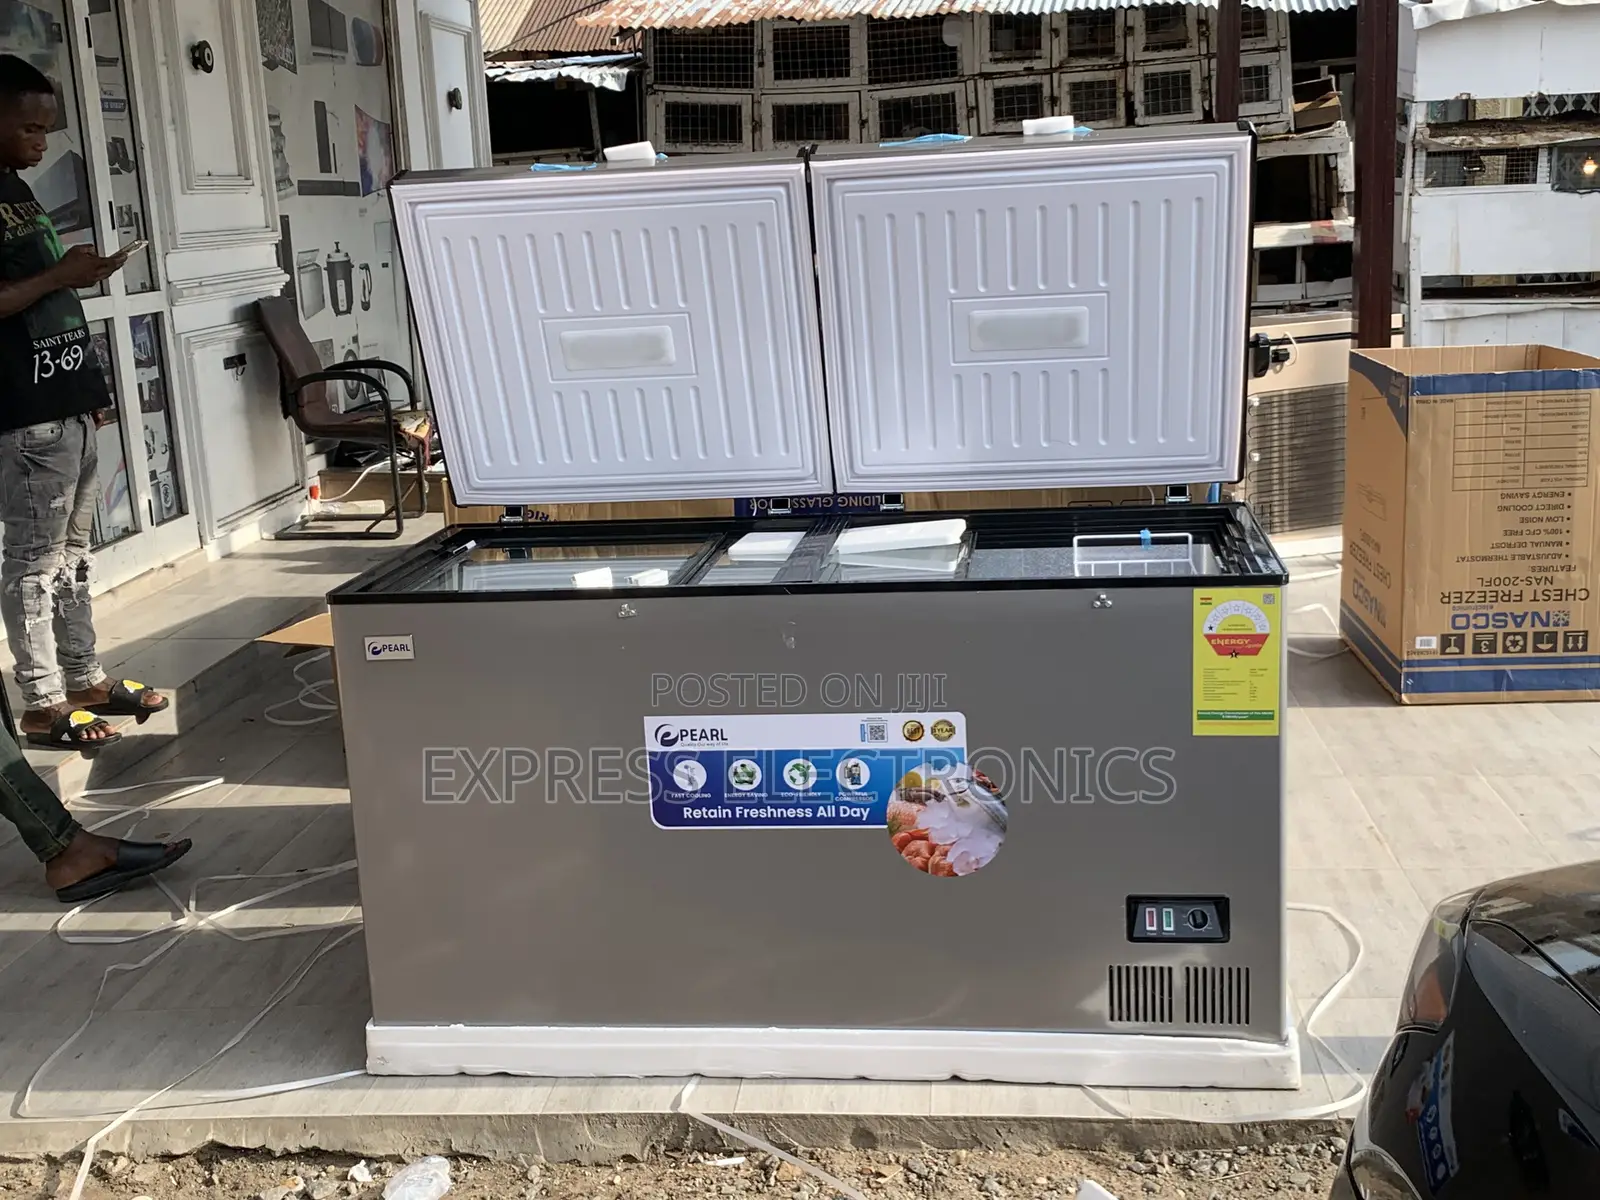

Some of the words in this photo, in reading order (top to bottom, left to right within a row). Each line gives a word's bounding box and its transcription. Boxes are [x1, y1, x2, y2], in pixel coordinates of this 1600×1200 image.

[33, 335, 62, 350] SAINT
[62, 329, 86, 343] TEARS
[33, 345, 84, 384] 13-69
[792, 497, 833, 508] GLASS
[1496, 504, 1533, 512] COOLING
[1519, 516, 1544, 524] NOISE
[1530, 540, 1562, 548] MANUAL
[1456, 554, 1508, 562] THERMOSTAT
[1510, 552, 1562, 560] ADJUSTABLE
[1528, 564, 1576, 572] FEATURES:
[1476, 576, 1554, 587] NAS-200FL
[1440, 590, 1523, 604] FREEZER
[1528, 588, 1590, 602] CHEST
[1451, 611, 1550, 630] NASCO
[382, 643, 411, 653] PEARL
[680, 728, 729, 742] PEARL
[683, 806, 733, 819] Retain
[735, 805, 813, 819] Freshness
[816, 805, 835, 818] All
[839, 805, 870, 821] Day
